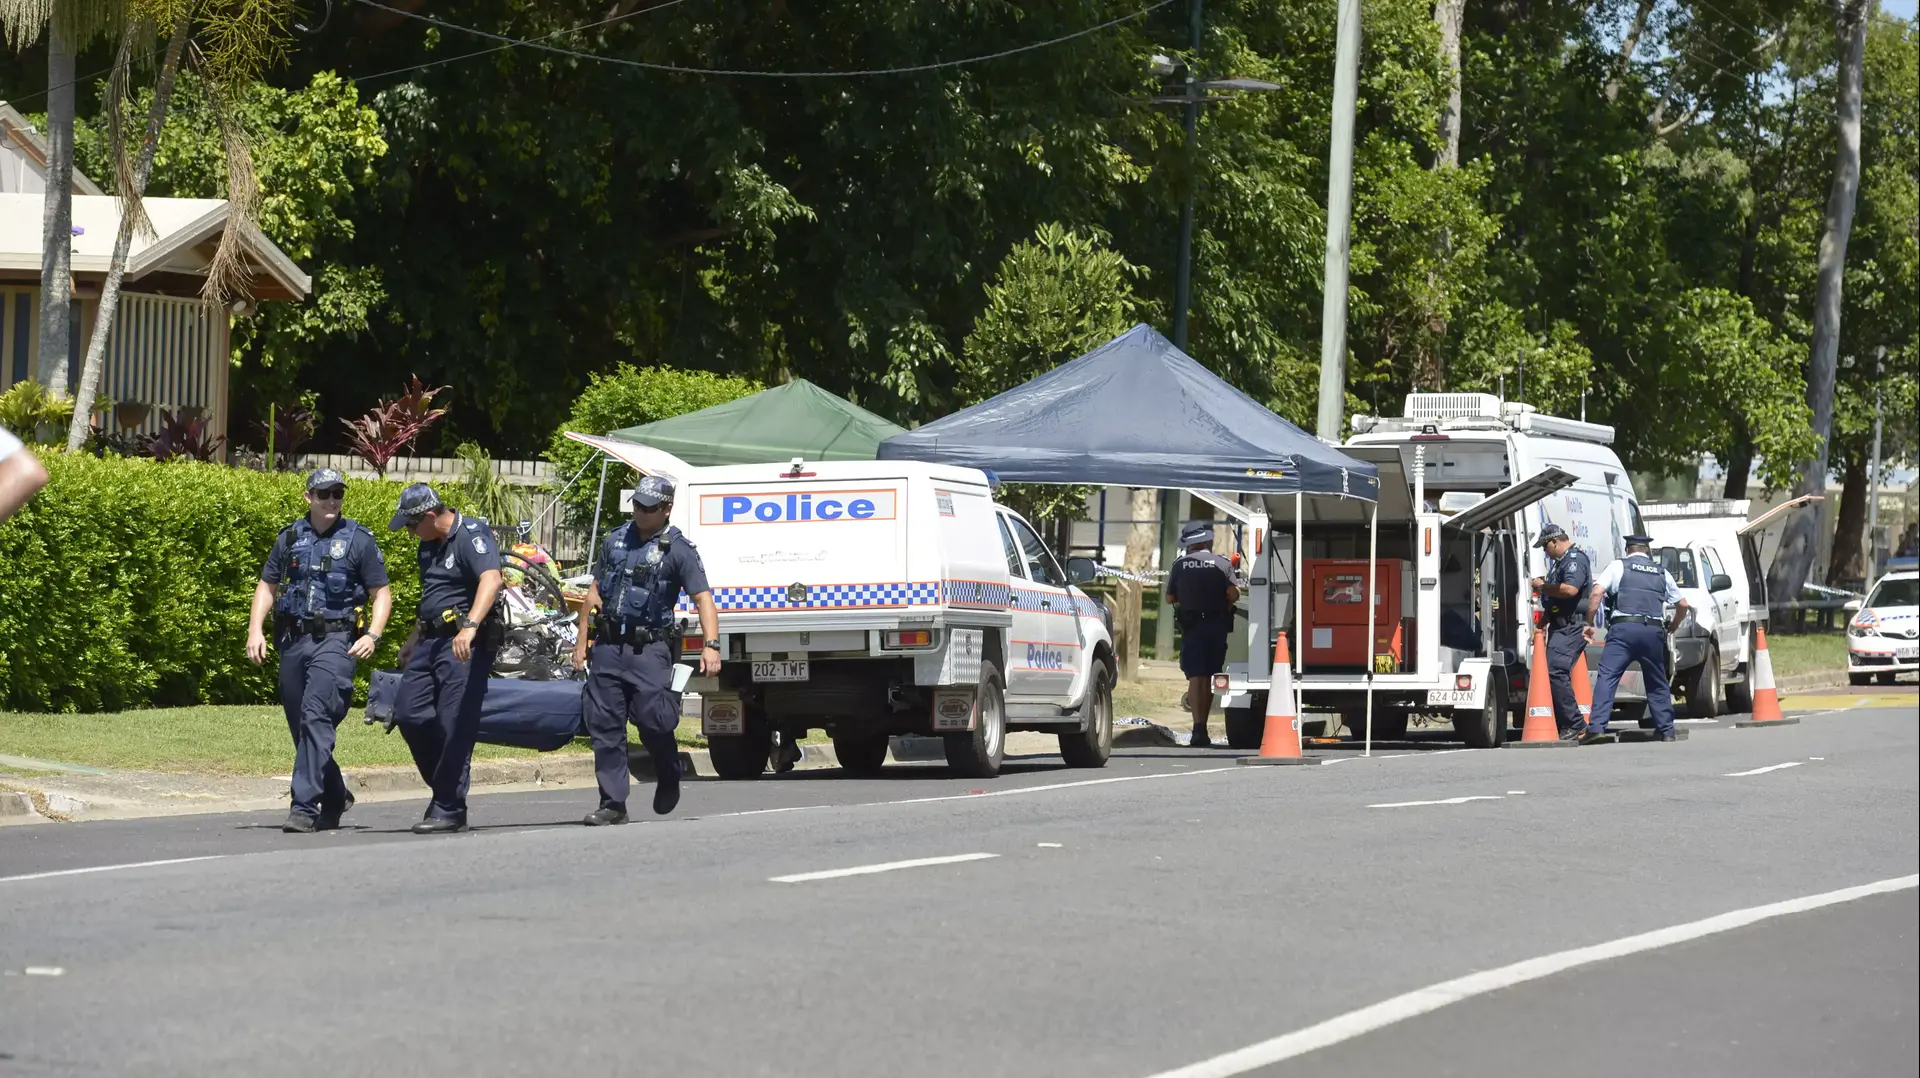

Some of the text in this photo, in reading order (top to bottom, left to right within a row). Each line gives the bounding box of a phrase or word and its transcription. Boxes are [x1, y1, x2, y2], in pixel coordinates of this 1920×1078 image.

[723, 494, 875, 523] Police
[1572, 520, 1588, 538] Police
[1182, 560, 1215, 569] POLICE
[1632, 563, 1658, 573] POLICE
[1027, 642, 1062, 669] Police
